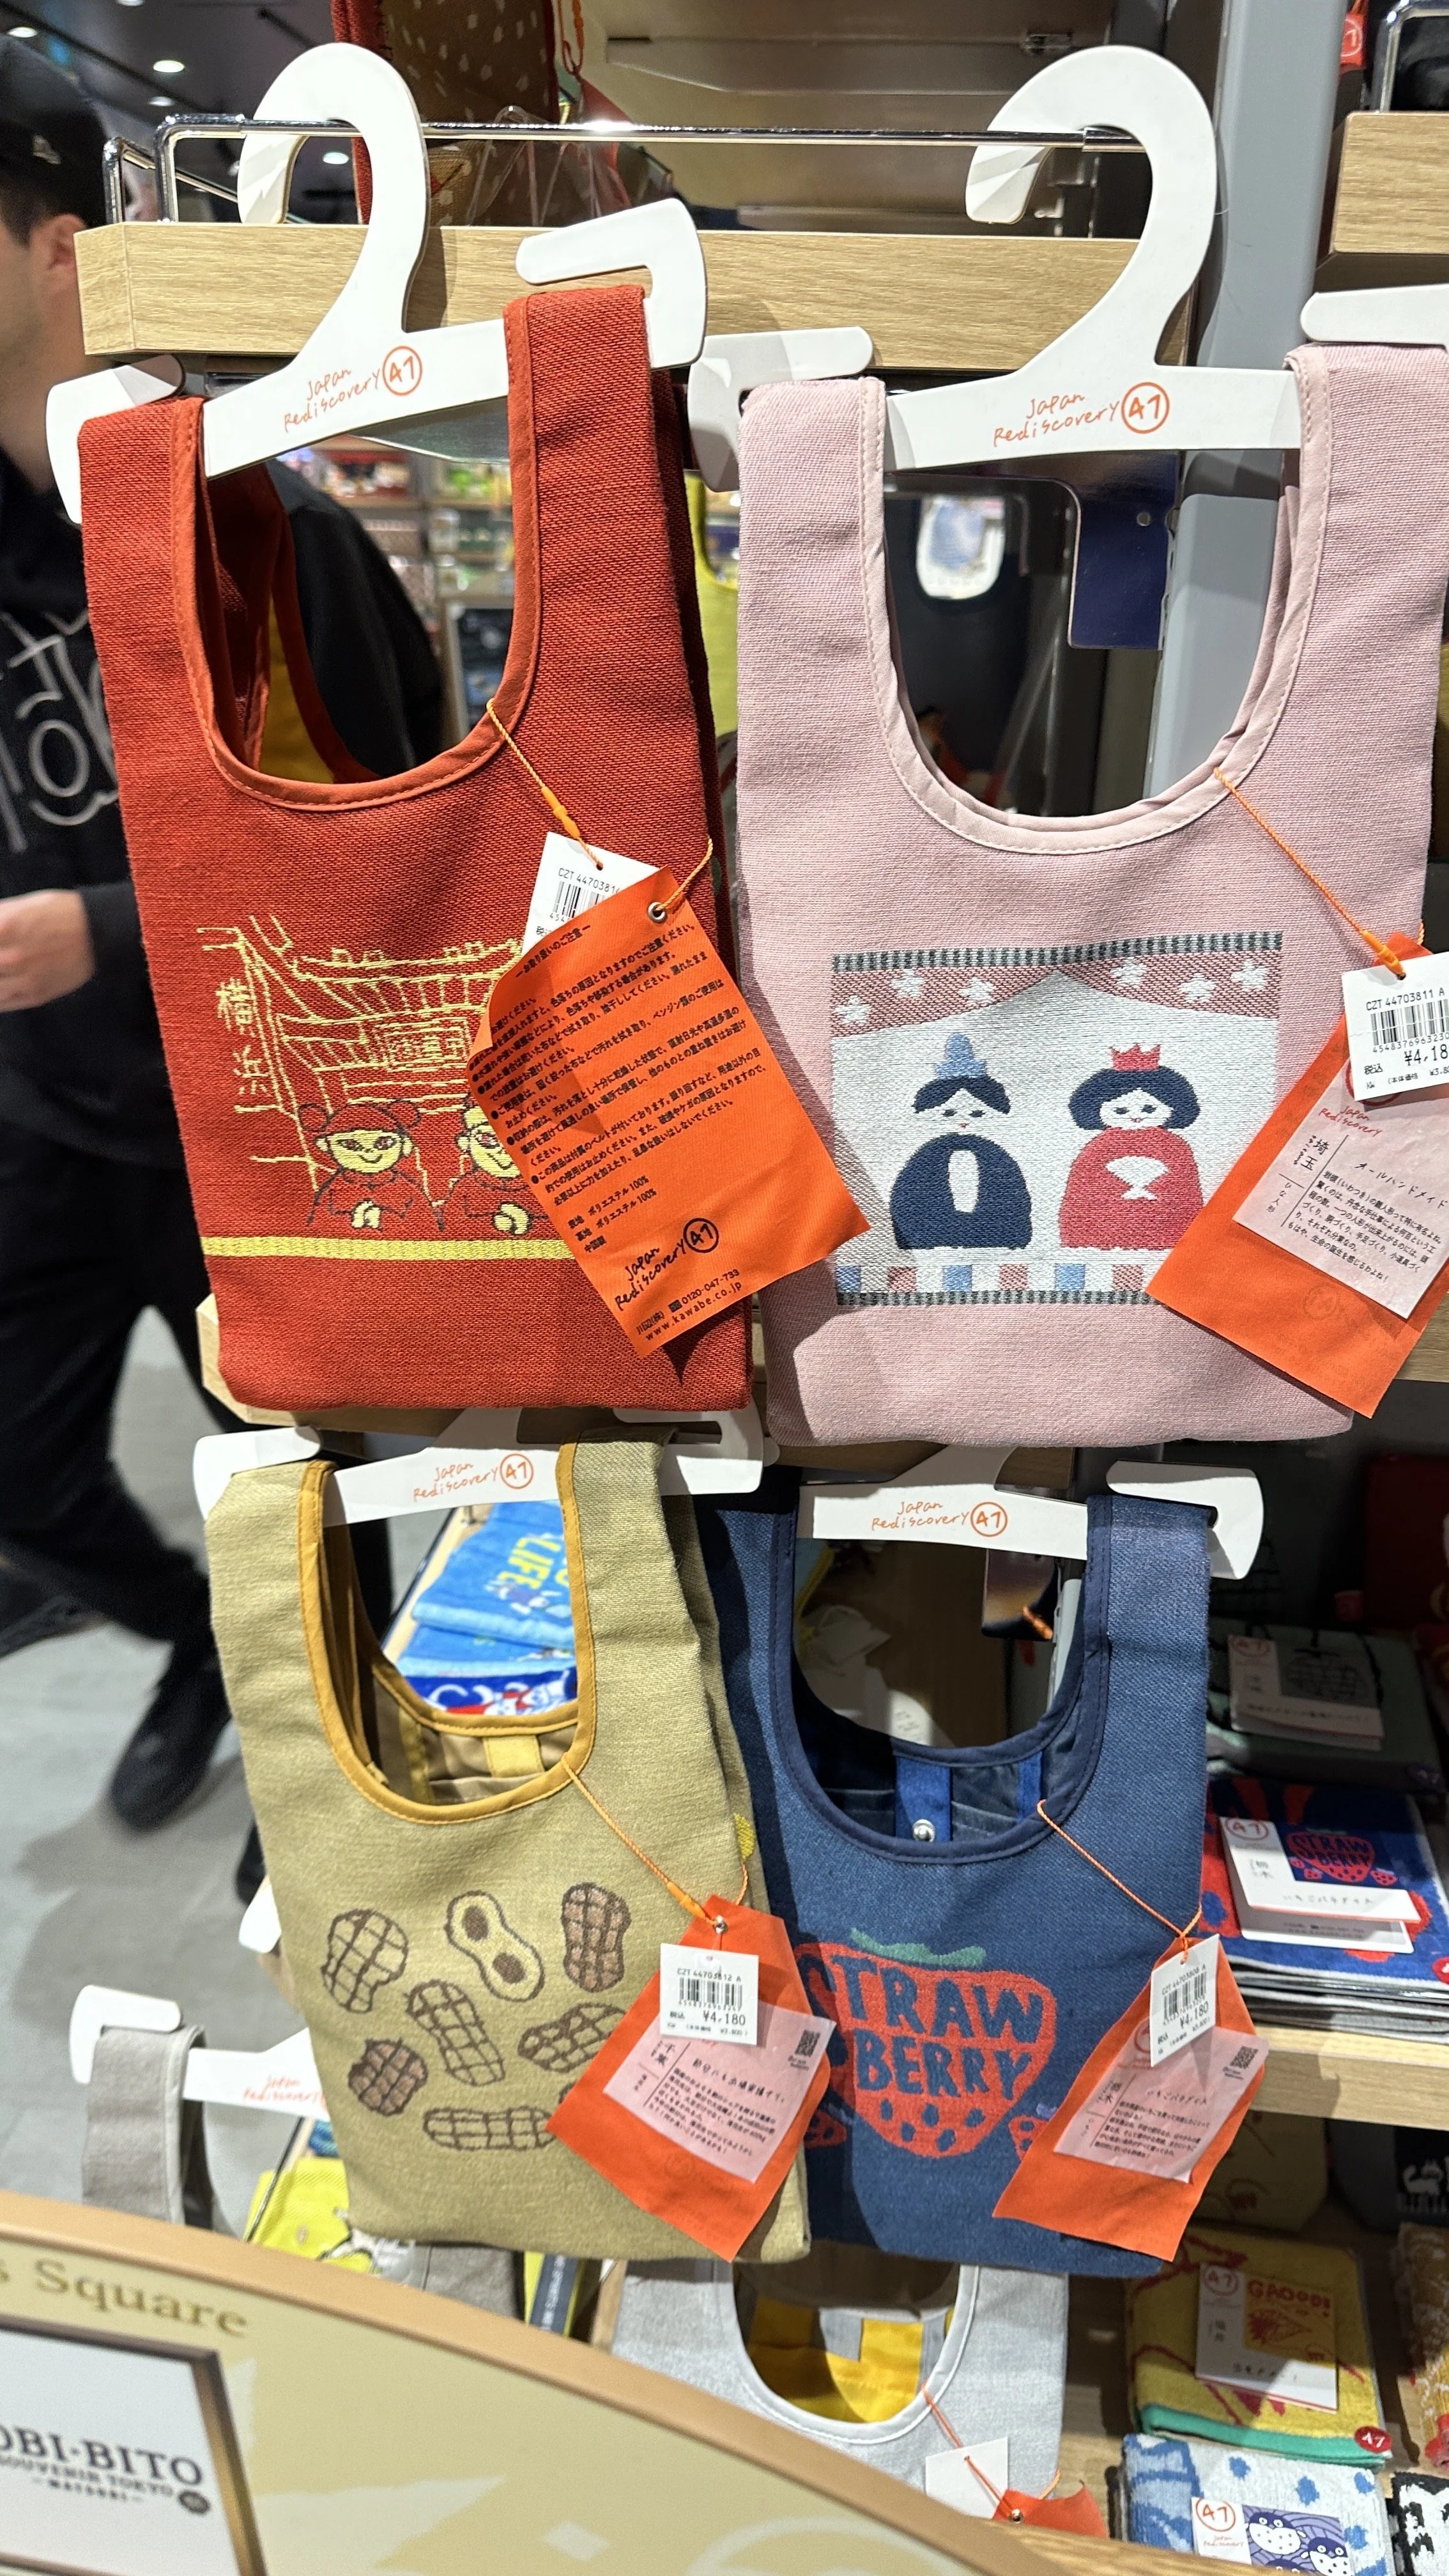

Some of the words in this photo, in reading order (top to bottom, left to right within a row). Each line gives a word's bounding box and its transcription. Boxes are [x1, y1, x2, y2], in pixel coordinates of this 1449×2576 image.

[307, 369, 351, 401] Japan
[284, 369, 381, 433] Rediscovery
[1029, 394, 1085, 418] Japan
[993, 401, 1119, 446] Rediscovery
[558, 868, 574, 880] CZT
[549, 913, 571, 923] 454
[1366, 999, 1382, 1011] CZT
[1385, 990, 1434, 1007] 44703811
[1438, 987, 1445, 996] A
[1404, 1044, 1449, 1066] ¥4,18
[1319, 1107, 1383, 1137] Rediscovery
[1340, 1106, 1370, 1123] Japan
[528, 1142, 562, 1167] ください。
[1300, 1137, 1328, 1172] 埼玉
[586, 1186, 631, 1218] ポリエステル
[628, 1174, 650, 1192] 100%
[594, 1199, 638, 1230] ポリエステル
[636, 1186, 657, 1205] 100%
[1266, 1181, 1292, 1214] ひな人形
[614, 1238, 687, 1311] Rediscovery
[622, 1246, 659, 1281] Japan
[680, 1267, 740, 1305] 0120-047-733
[643, 1279, 743, 1342] www.kawabe.co.jp
[413, 1468, 499, 1501] Rediscovery
[434, 1462, 473, 1482] Japan
[871, 1512, 970, 1532] Rediscovery
[897, 1499, 943, 1516] Japan
[702, 2010, 746, 2025] ¥4,180
[1179, 2001, 1209, 2028] ¥4,180
[854, 2029, 1032, 2100] BERRY
[33, 2257, 248, 2338] Square
[1203, 2503, 1228, 2522] 47
